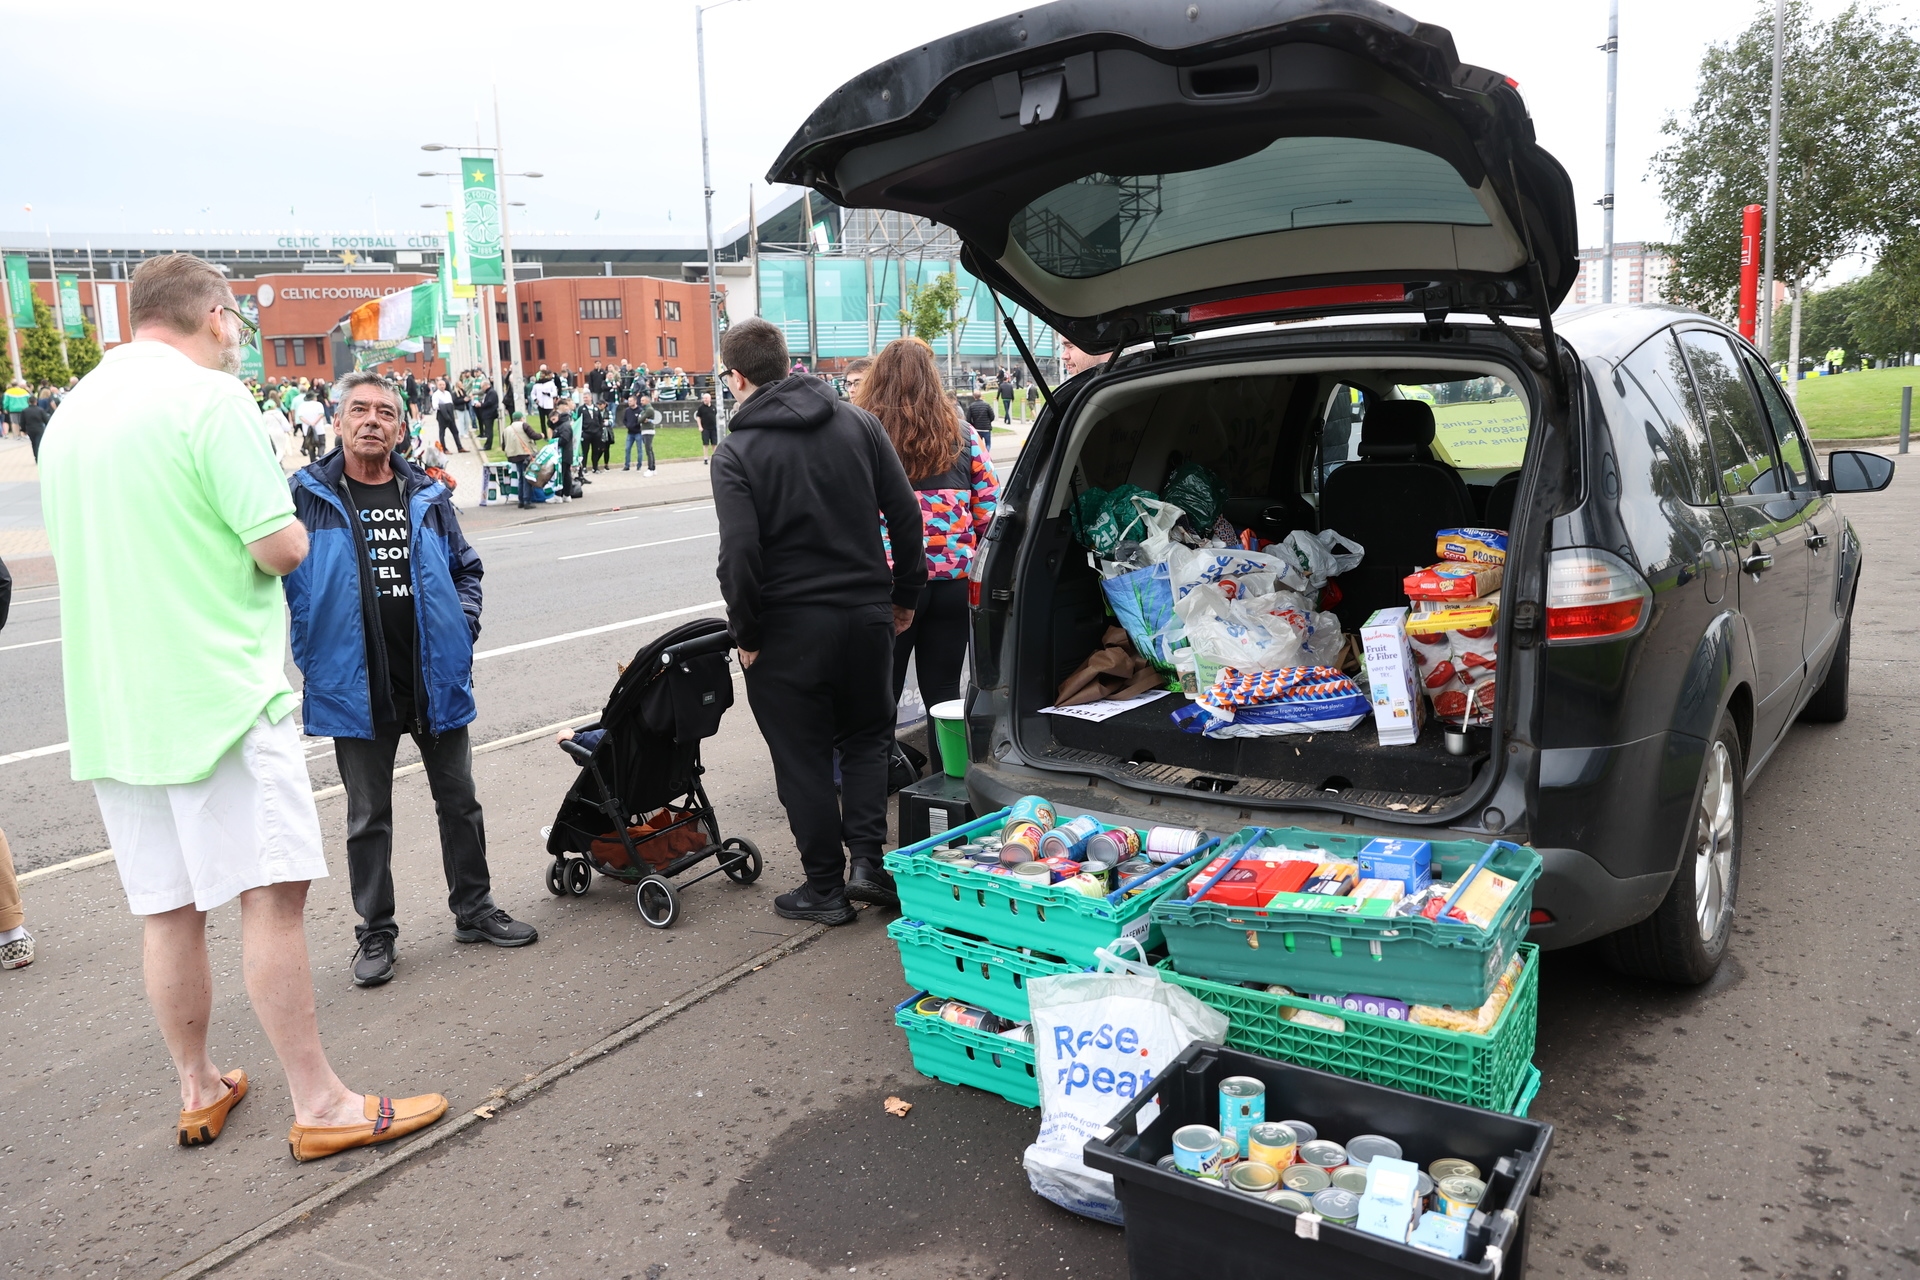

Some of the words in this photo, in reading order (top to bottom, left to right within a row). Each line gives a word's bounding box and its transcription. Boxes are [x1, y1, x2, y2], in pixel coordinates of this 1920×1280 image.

[278, 237, 320, 248] CELTIC
[332, 237, 396, 248] FOOTBALL
[408, 237, 439, 248] CLUB
[280, 288, 320, 300] CELTIC
[322, 288, 384, 299] FOOTBALL
[663, 410, 690, 423] THE
[357, 508, 407, 522] COCK
[1472, 550, 1504, 563] PROSTY
[1366, 644, 1387, 653] Fruit
[1376, 652, 1398, 660] Fibre
[1068, 1122, 1086, 1137] long
[1080, 1118, 1100, 1130] from
[1382, 1215, 1387, 1223] 3
